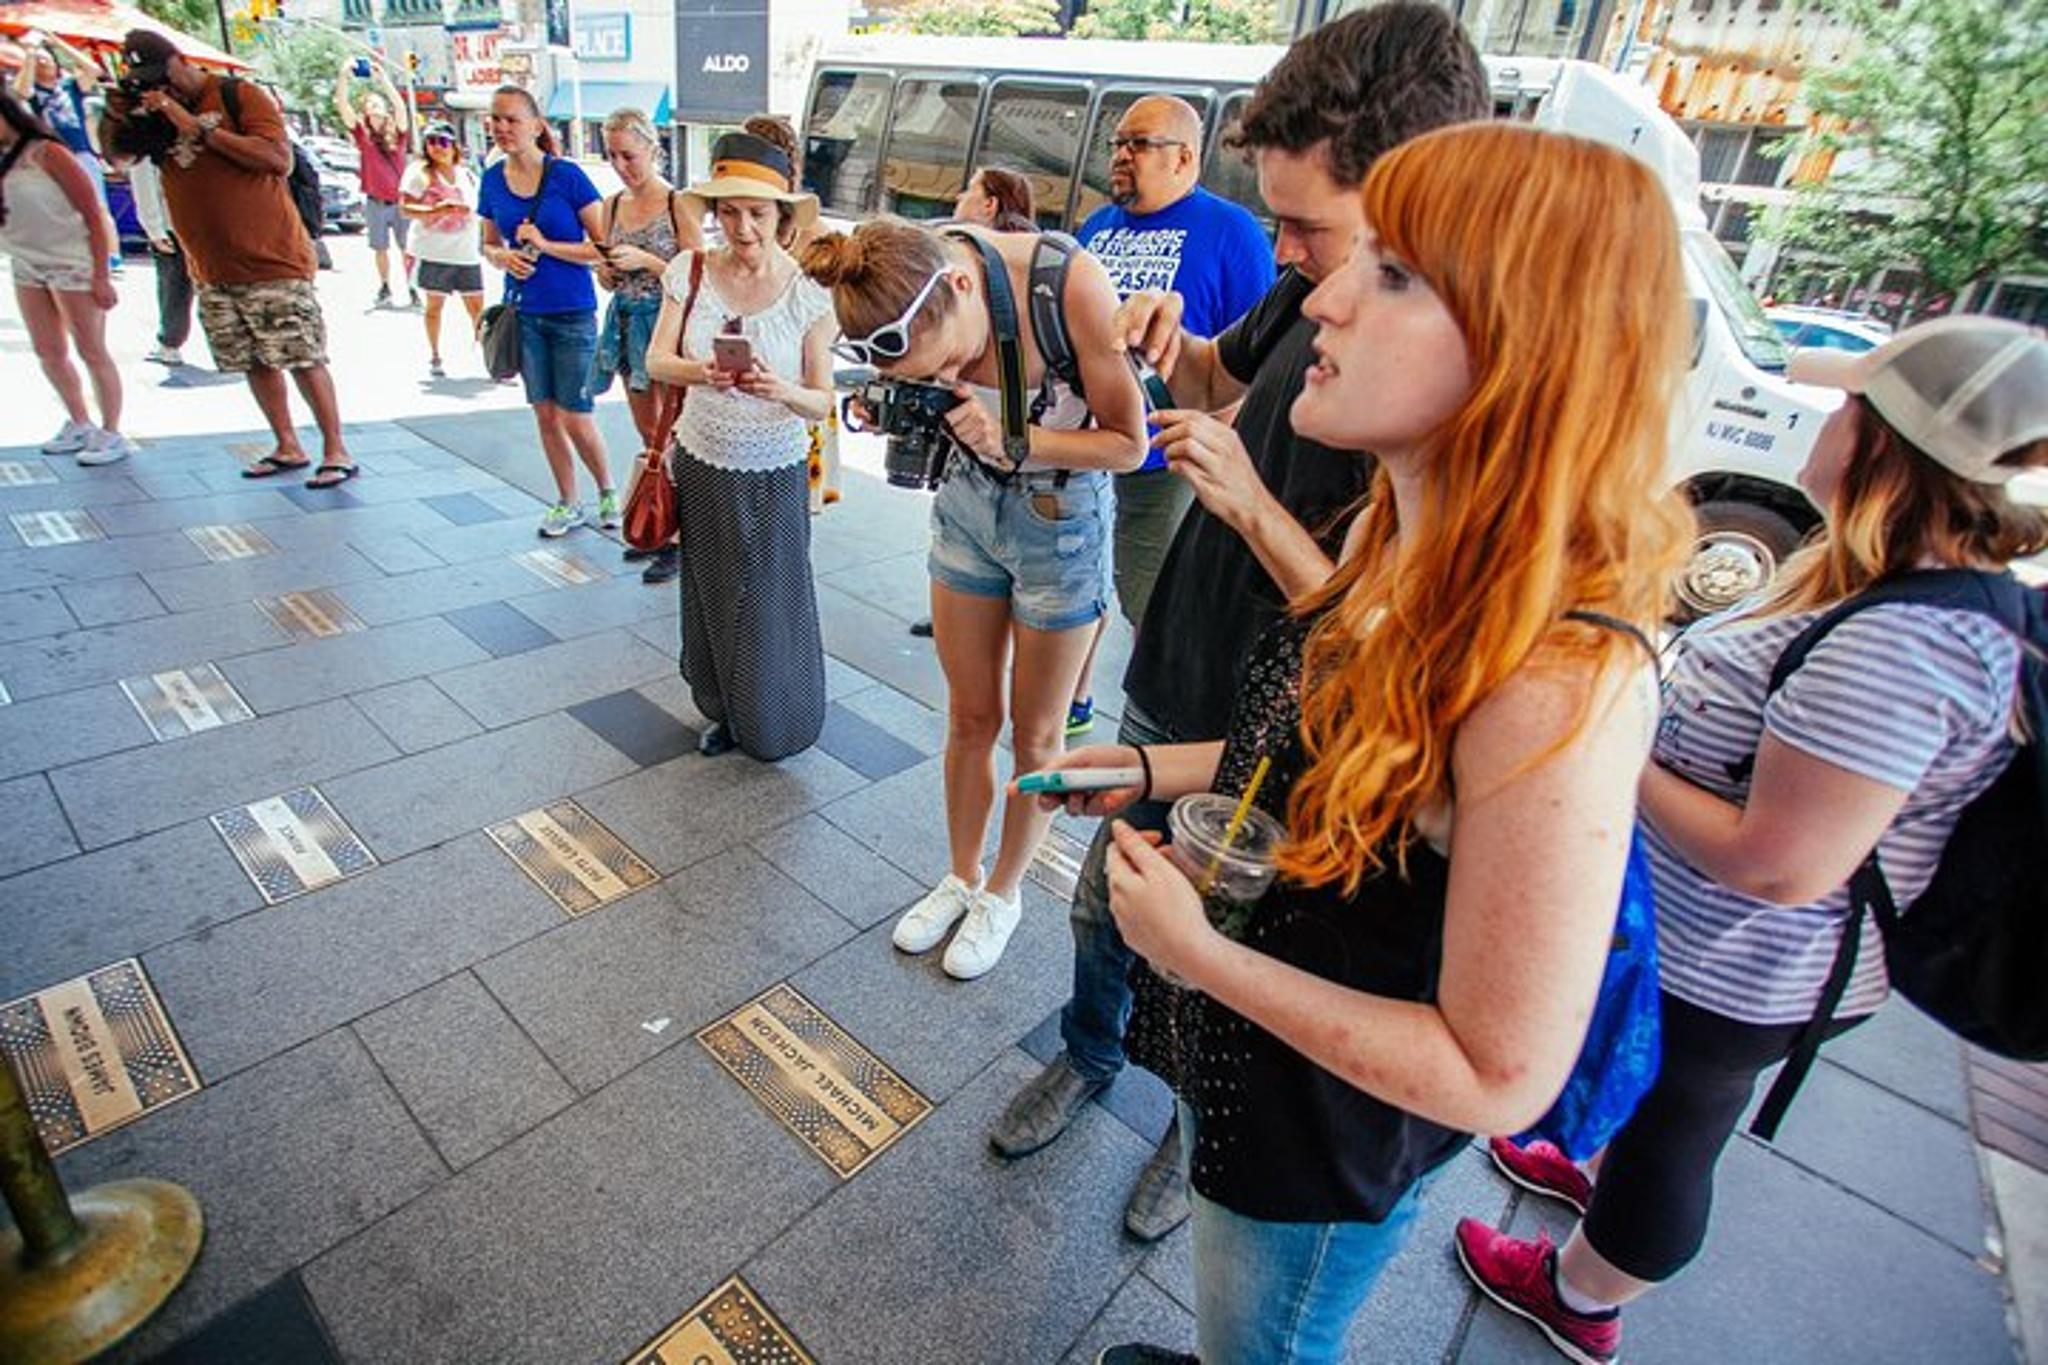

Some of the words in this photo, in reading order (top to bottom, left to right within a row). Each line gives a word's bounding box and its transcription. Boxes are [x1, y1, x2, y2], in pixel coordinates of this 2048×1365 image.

[702, 54, 749, 72] ALDO
[1631, 127, 1642, 146] 1
[1786, 412, 1799, 430] 1
[749, 1016, 816, 1071] JACKSON
[81, 1052, 116, 1096] JAMES
[814, 1071, 881, 1132] MICHAEL
